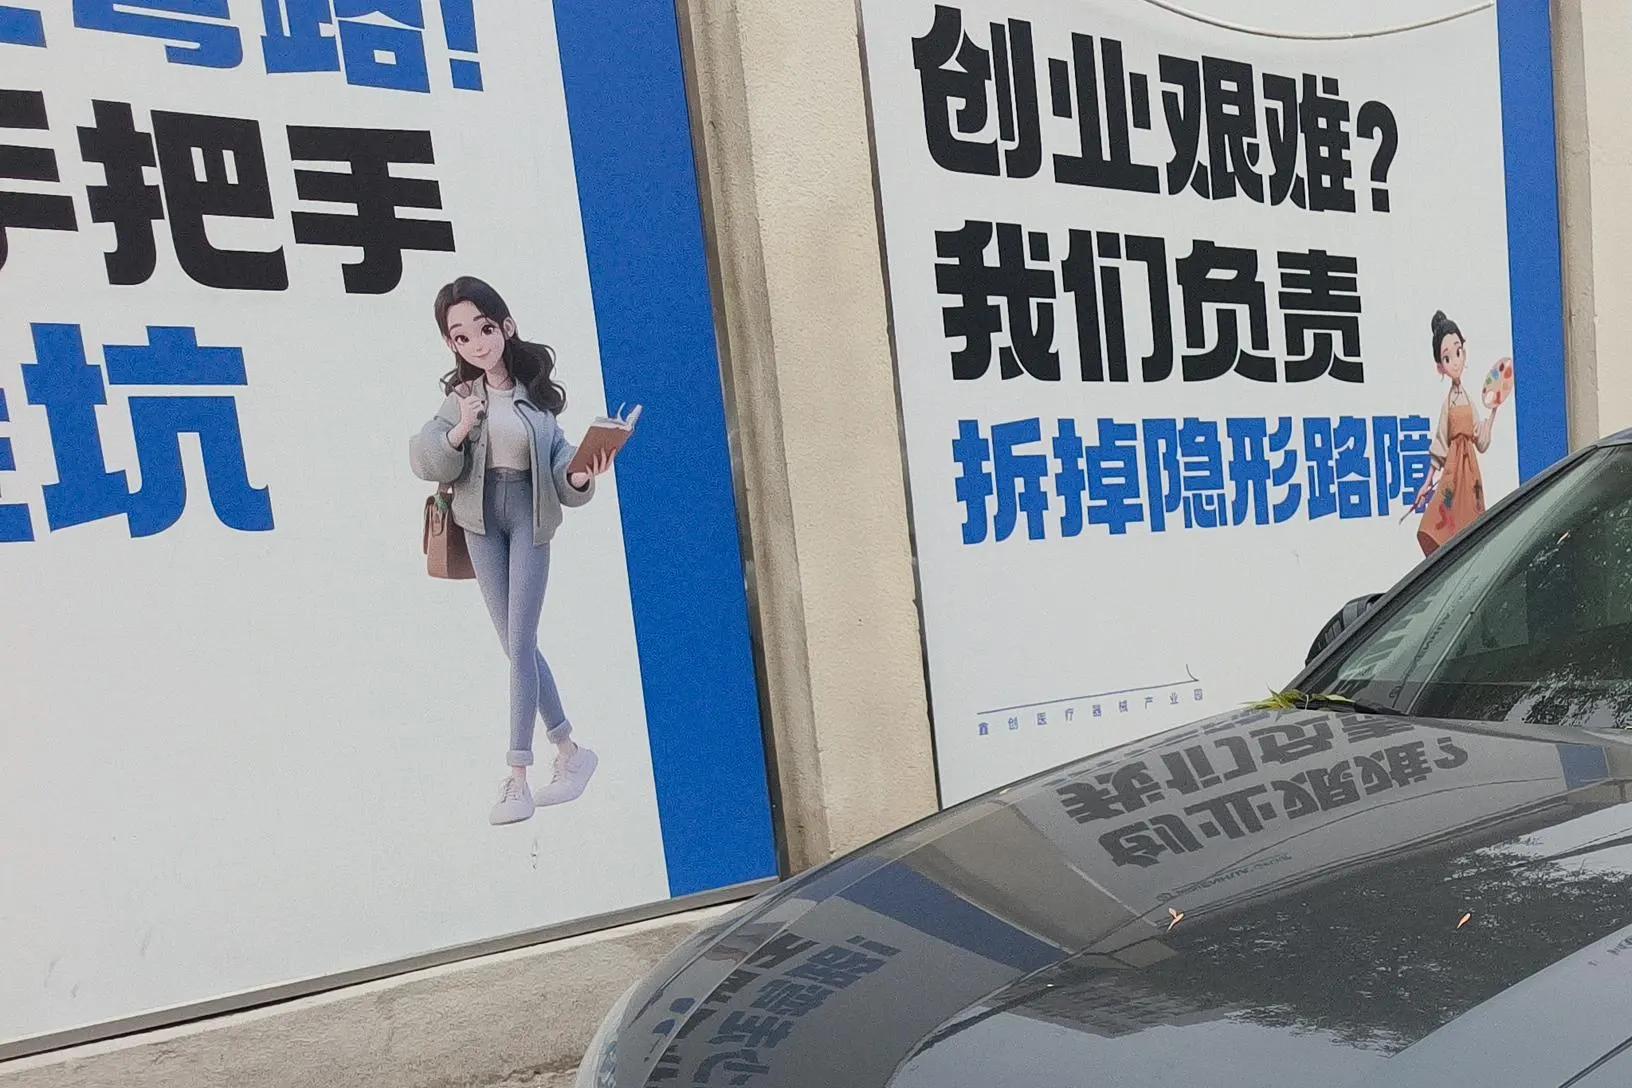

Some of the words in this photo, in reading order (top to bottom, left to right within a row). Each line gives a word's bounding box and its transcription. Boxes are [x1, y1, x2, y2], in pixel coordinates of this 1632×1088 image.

[911, 4, 1399, 214] 创业艰难?
[934, 219, 1366, 384] 我们负责
[0, 322, 275, 542] 坑
[952, 414, 1434, 546] 拆掉隐形路障
